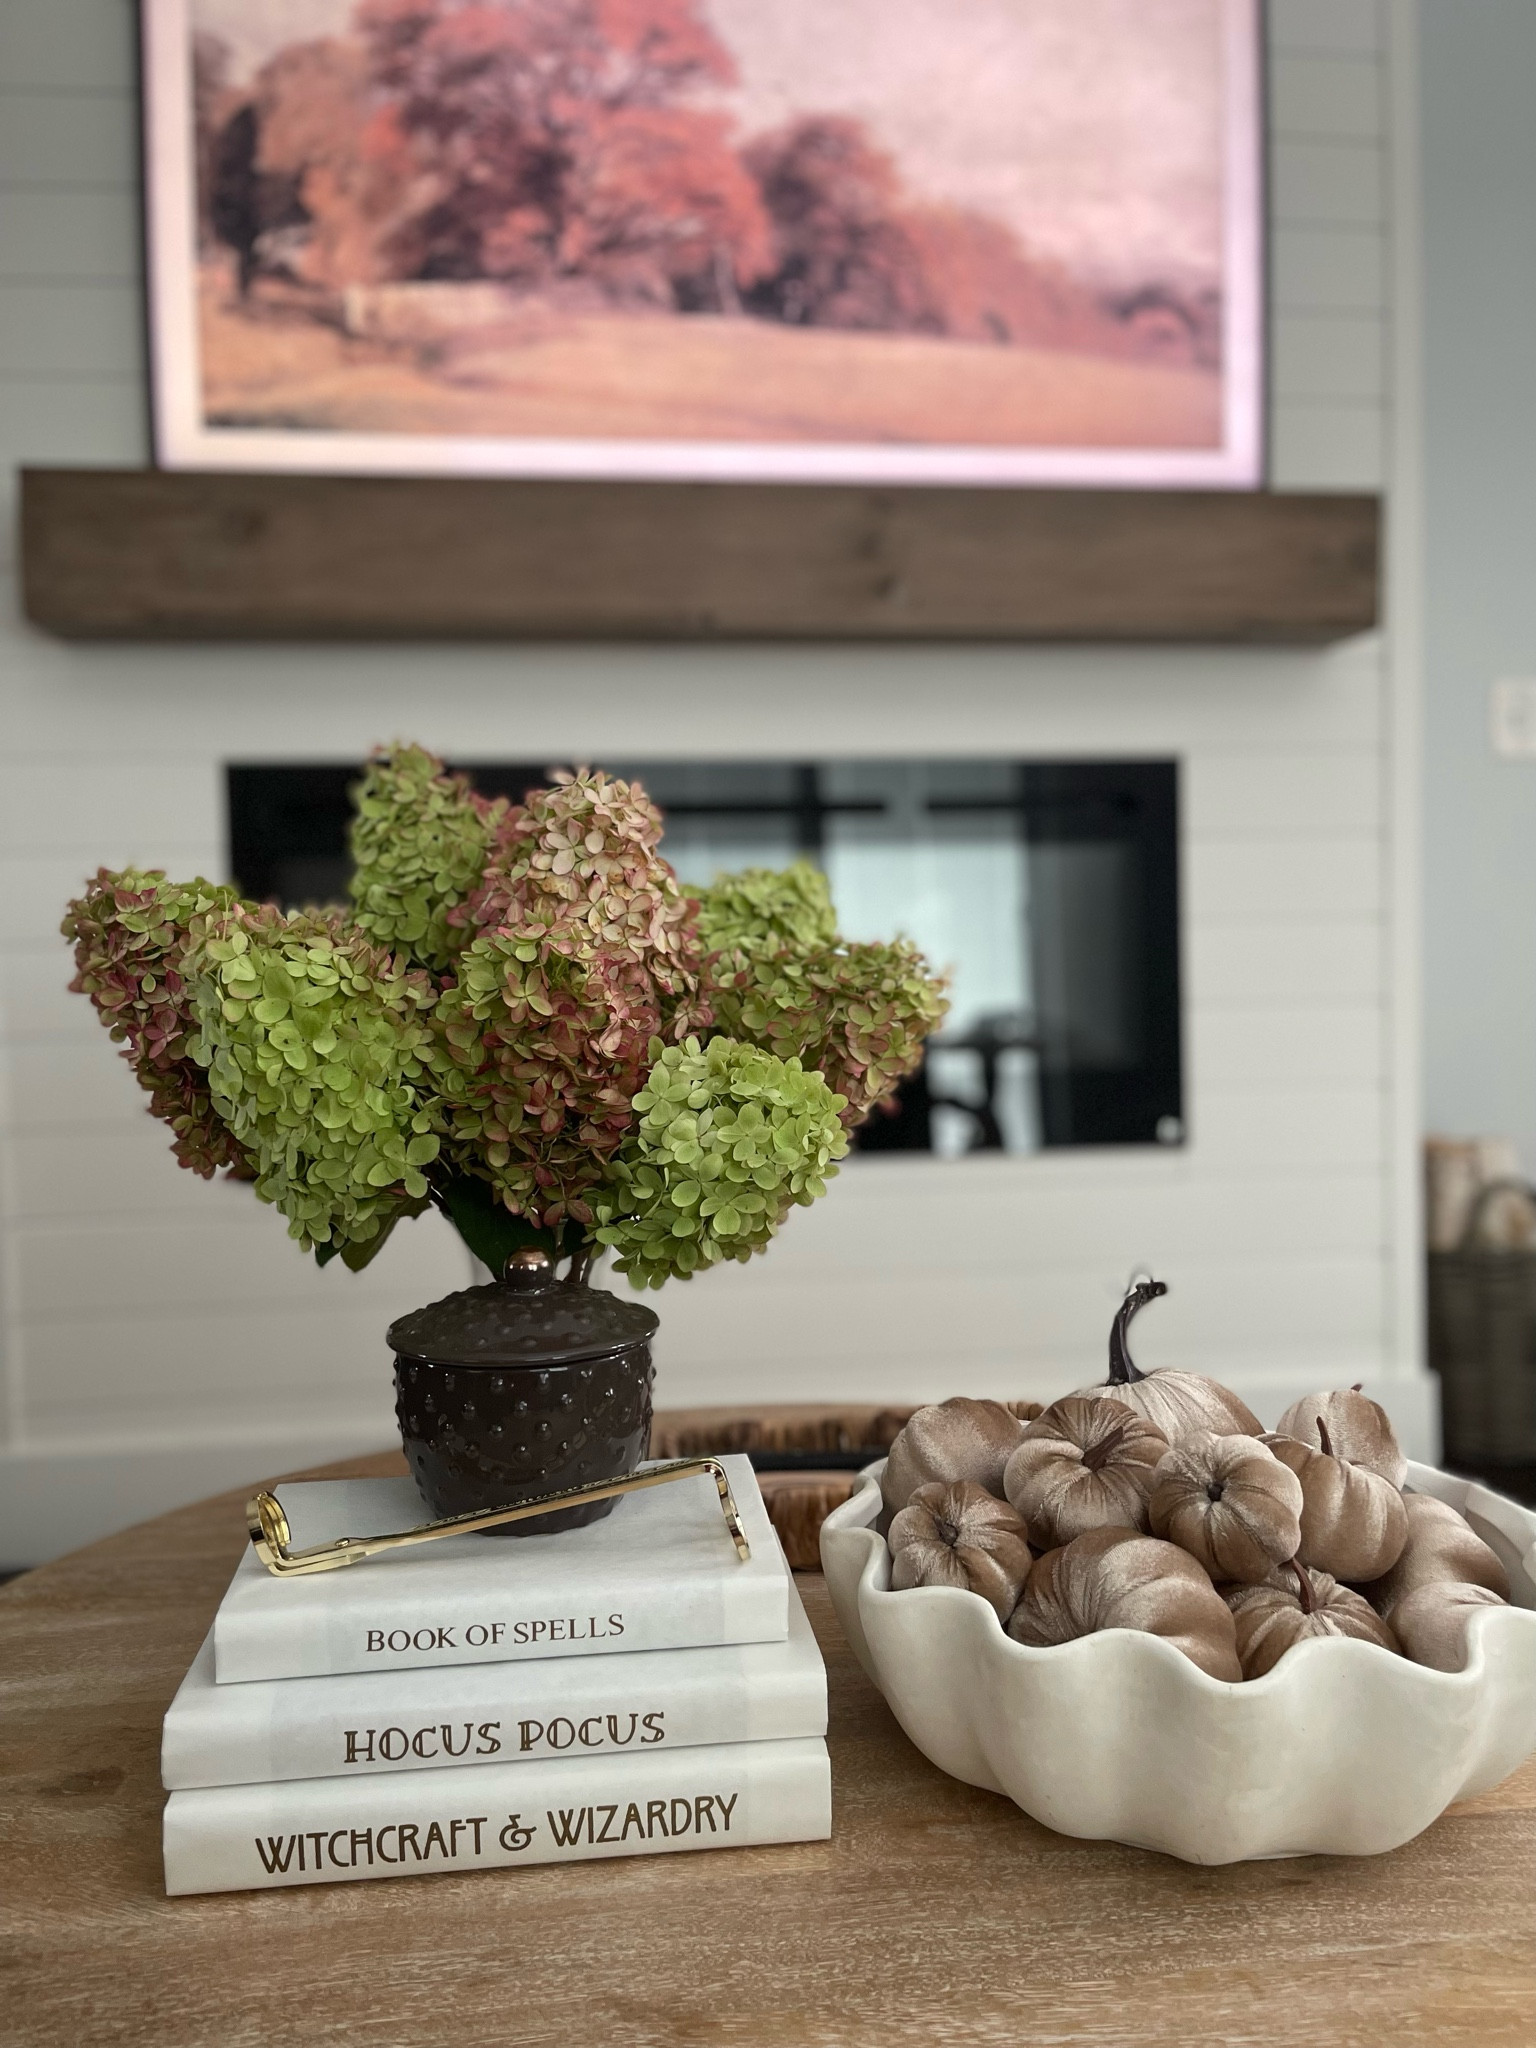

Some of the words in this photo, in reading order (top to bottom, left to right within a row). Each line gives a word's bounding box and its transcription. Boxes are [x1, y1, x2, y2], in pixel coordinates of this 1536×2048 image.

[365, 1626, 459, 1652] BOOK
[465, 1622, 507, 1647] OF
[513, 1613, 625, 1645] SPELLS
[343, 1720, 502, 1764] HOCUS
[517, 1711, 665, 1752] POCUS
[254, 1816, 489, 1875] WITCHCRAFT
[498, 1813, 538, 1852] &
[546, 1792, 739, 1848] WIZARDRY
